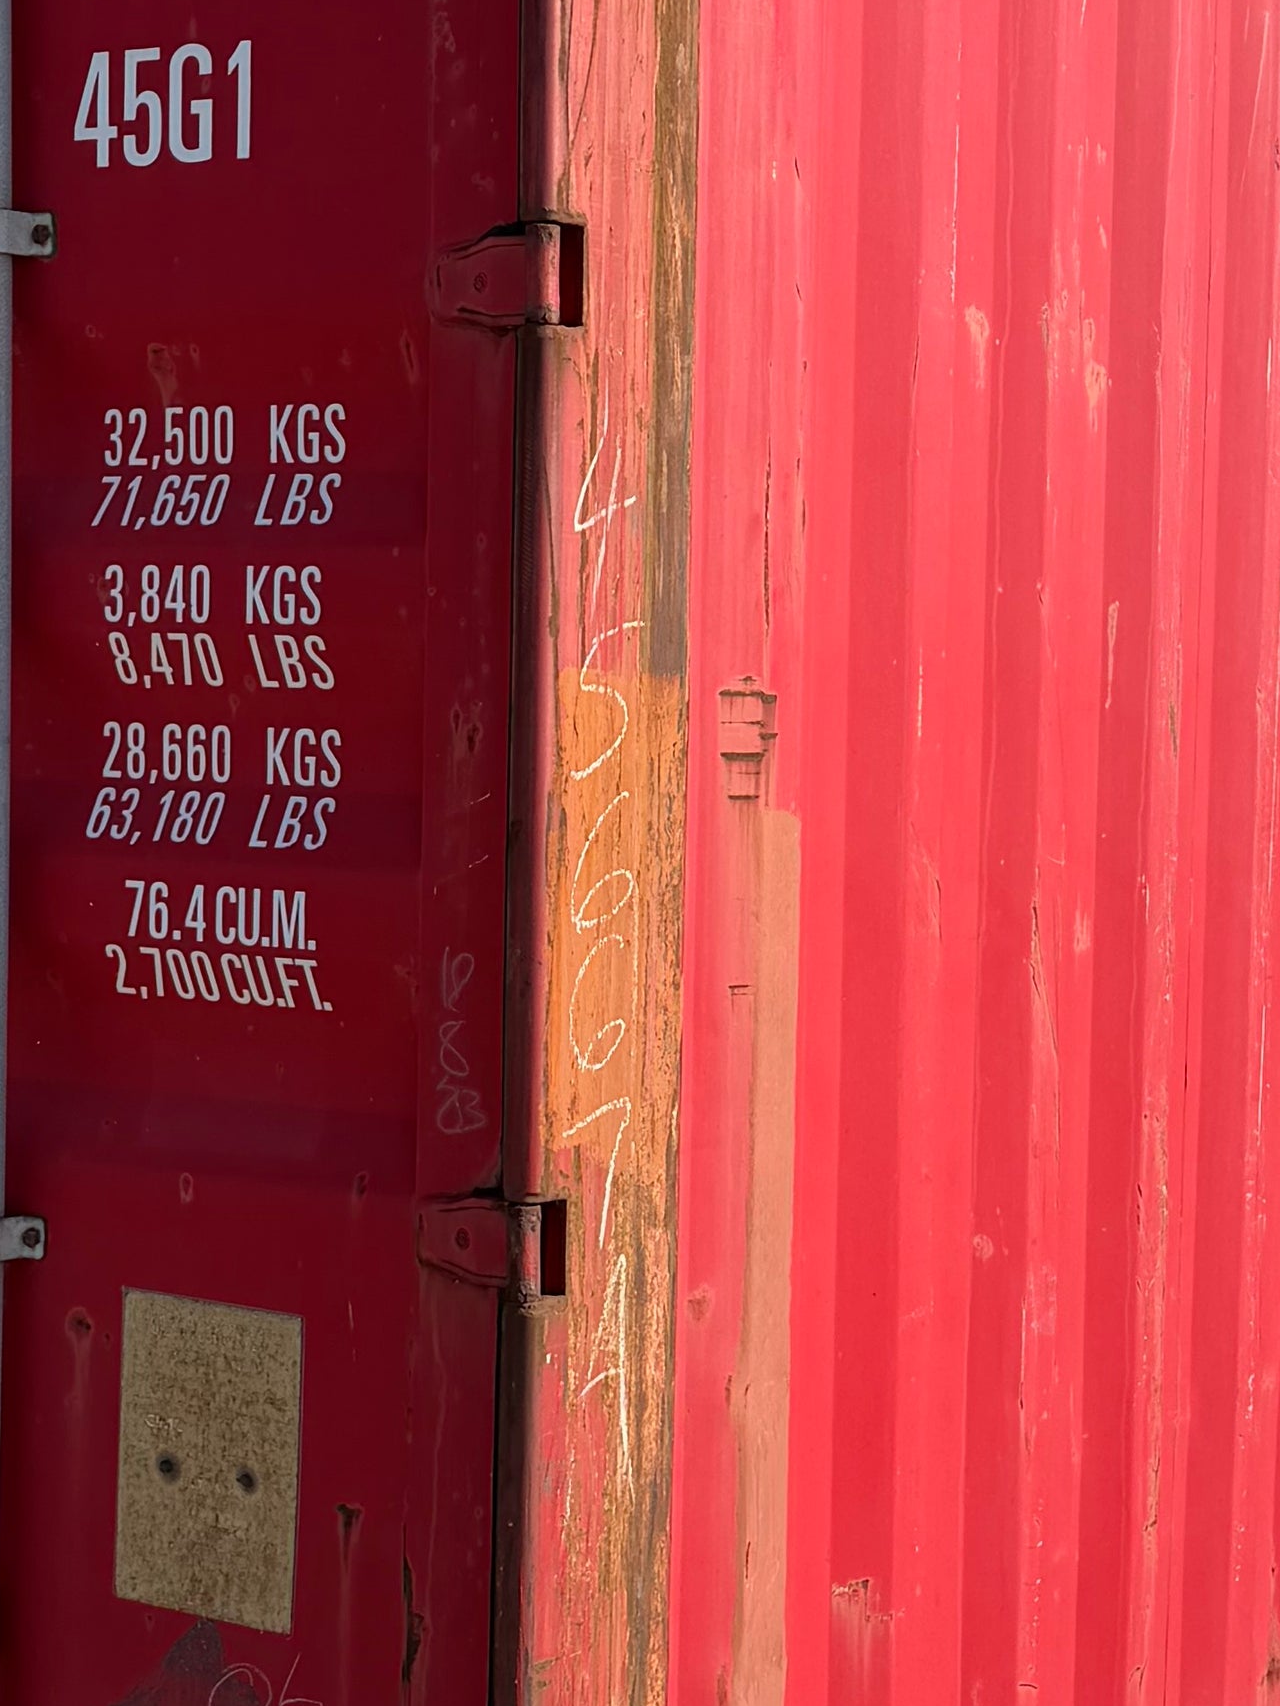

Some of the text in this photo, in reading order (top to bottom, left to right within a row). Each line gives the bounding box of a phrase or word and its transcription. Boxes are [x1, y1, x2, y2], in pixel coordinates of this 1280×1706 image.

[73, 39, 252, 168] 45G1
[104, 405, 234, 470] 32,500
[269, 403, 346, 464] KGS
[91, 472, 342, 530] 71,650 LBS
[104, 564, 212, 627] 3,840
[245, 565, 322, 626] KGS
[108, 631, 335, 690] 8,470 LBS
[102, 721, 231, 784] 28,660
[266, 726, 342, 788] KGS
[86, 786, 336, 851] 63,180 LBS
[124, 879, 207, 943] 76.4
[215, 885, 318, 951] CU.M.
[105, 943, 333, 1012] 2,700 CU.FT.
